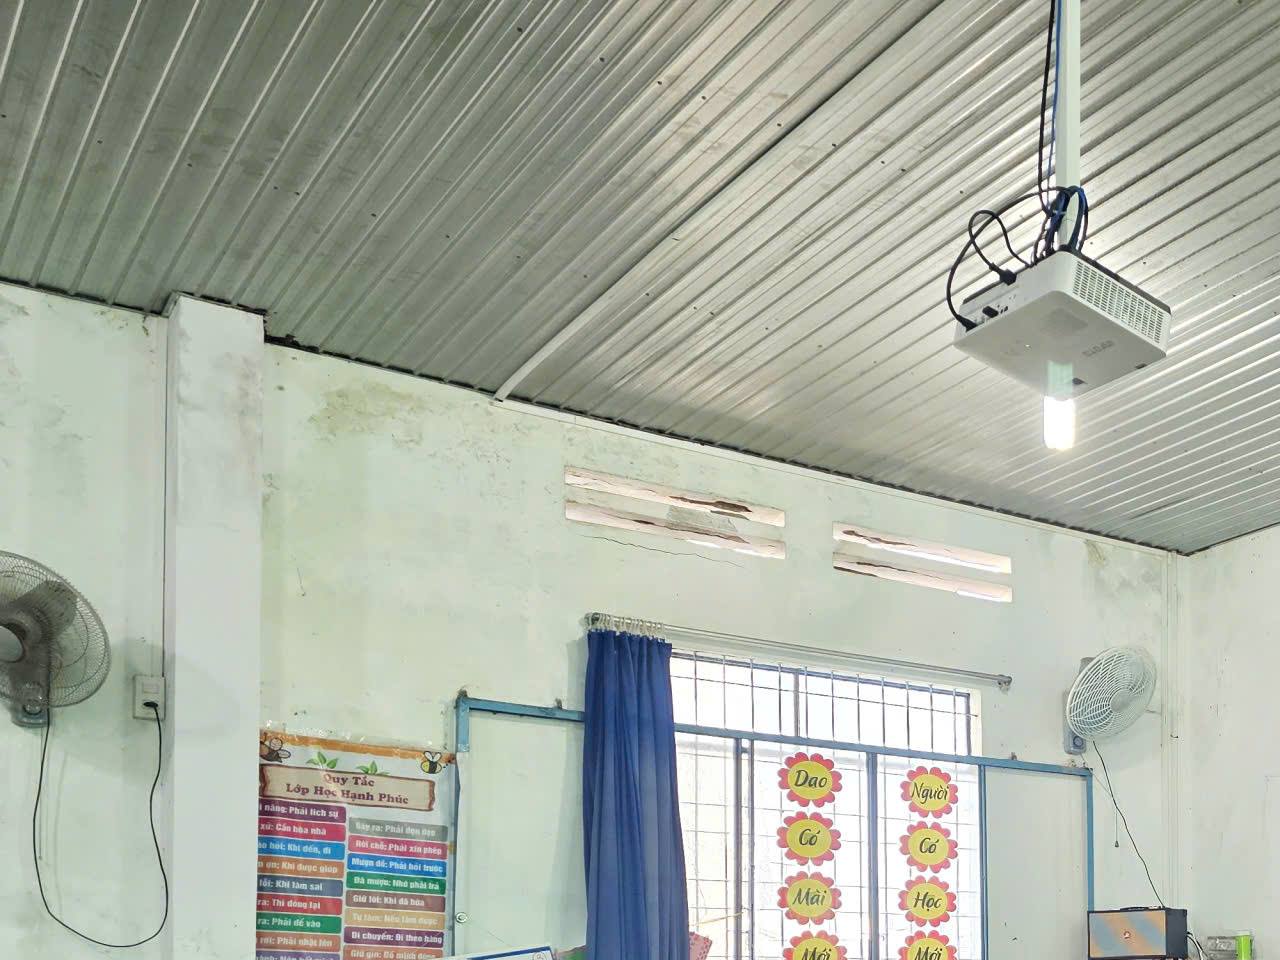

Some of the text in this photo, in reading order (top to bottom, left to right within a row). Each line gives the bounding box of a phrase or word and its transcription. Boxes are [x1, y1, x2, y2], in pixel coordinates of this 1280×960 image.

[324, 774, 374, 786] Quy Tắc
[794, 769, 827, 789] Dao
[286, 784, 408, 804] Lớp Học Hạnh Phúc
[909, 784, 949, 803] Người
[799, 826, 821, 846] Có
[919, 836, 940, 854] Có
[792, 886, 826, 907] Mài
[914, 891, 942, 912] Học
